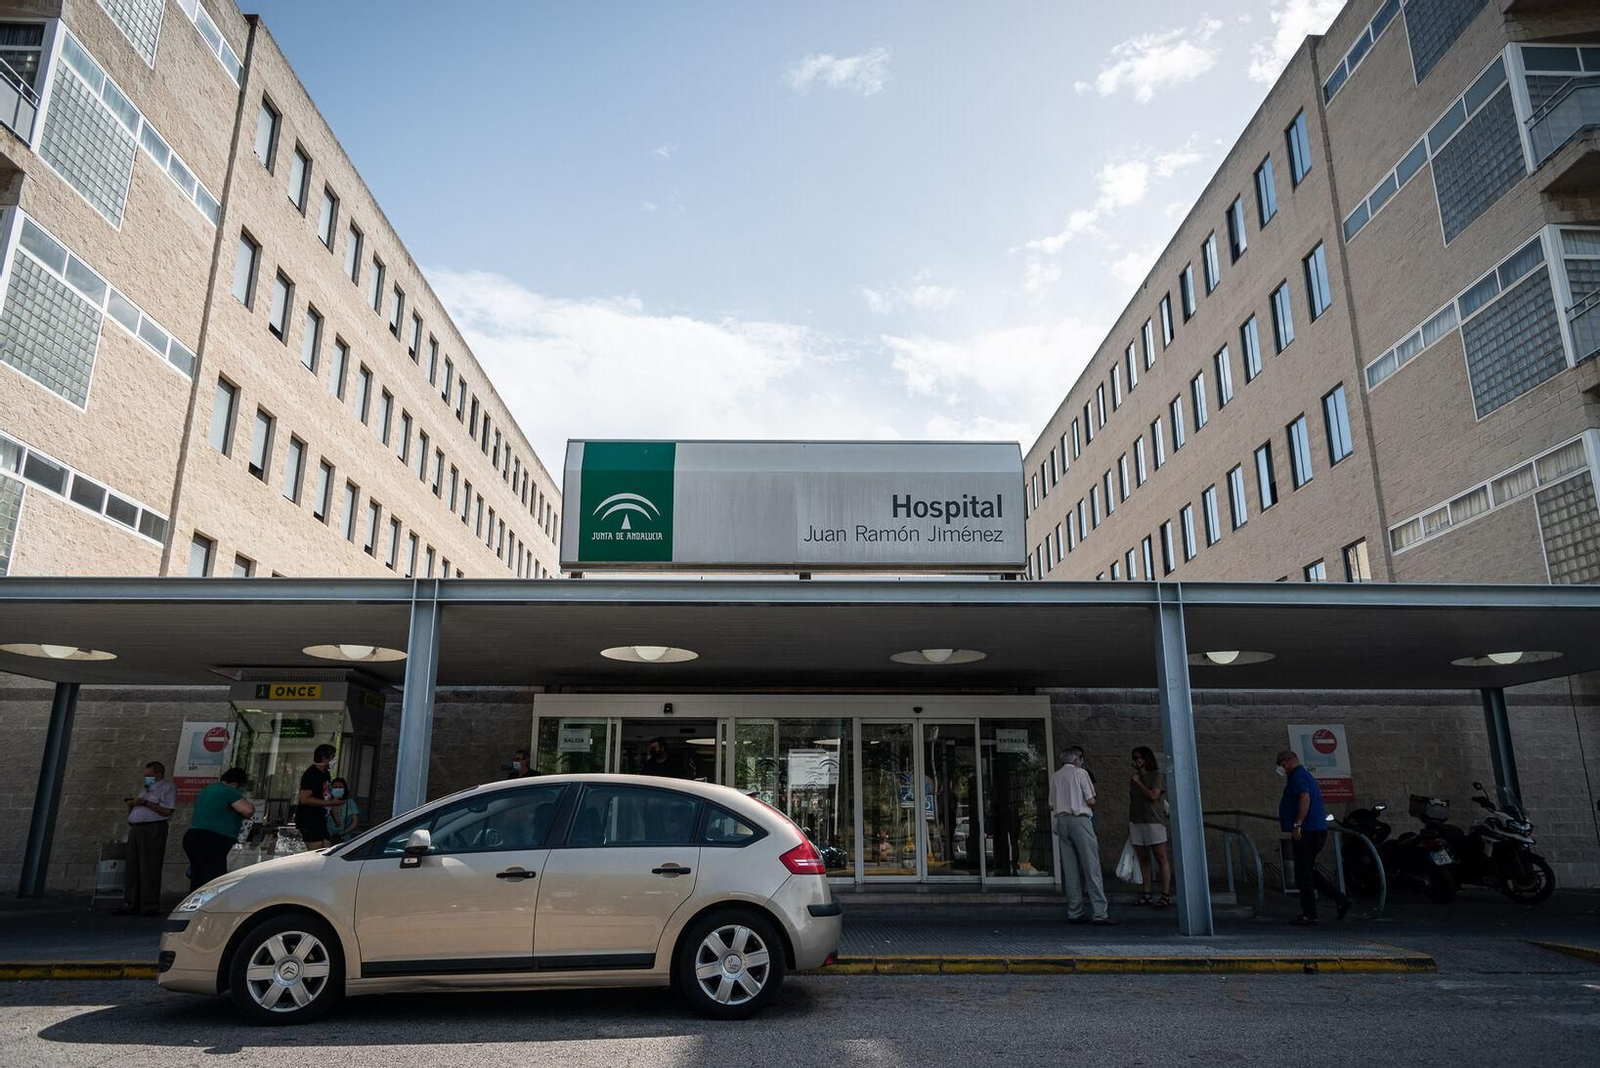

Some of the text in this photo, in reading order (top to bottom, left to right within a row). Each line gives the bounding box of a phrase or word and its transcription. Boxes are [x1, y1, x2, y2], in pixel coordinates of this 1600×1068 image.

[892, 494, 1002, 524] Hospital
[592, 532, 613, 540] JUNTA
[615, 532, 624, 540] DE
[805, 525, 1004, 542] Juan Ramón Jiménez
[275, 686, 316, 697] ONCE
